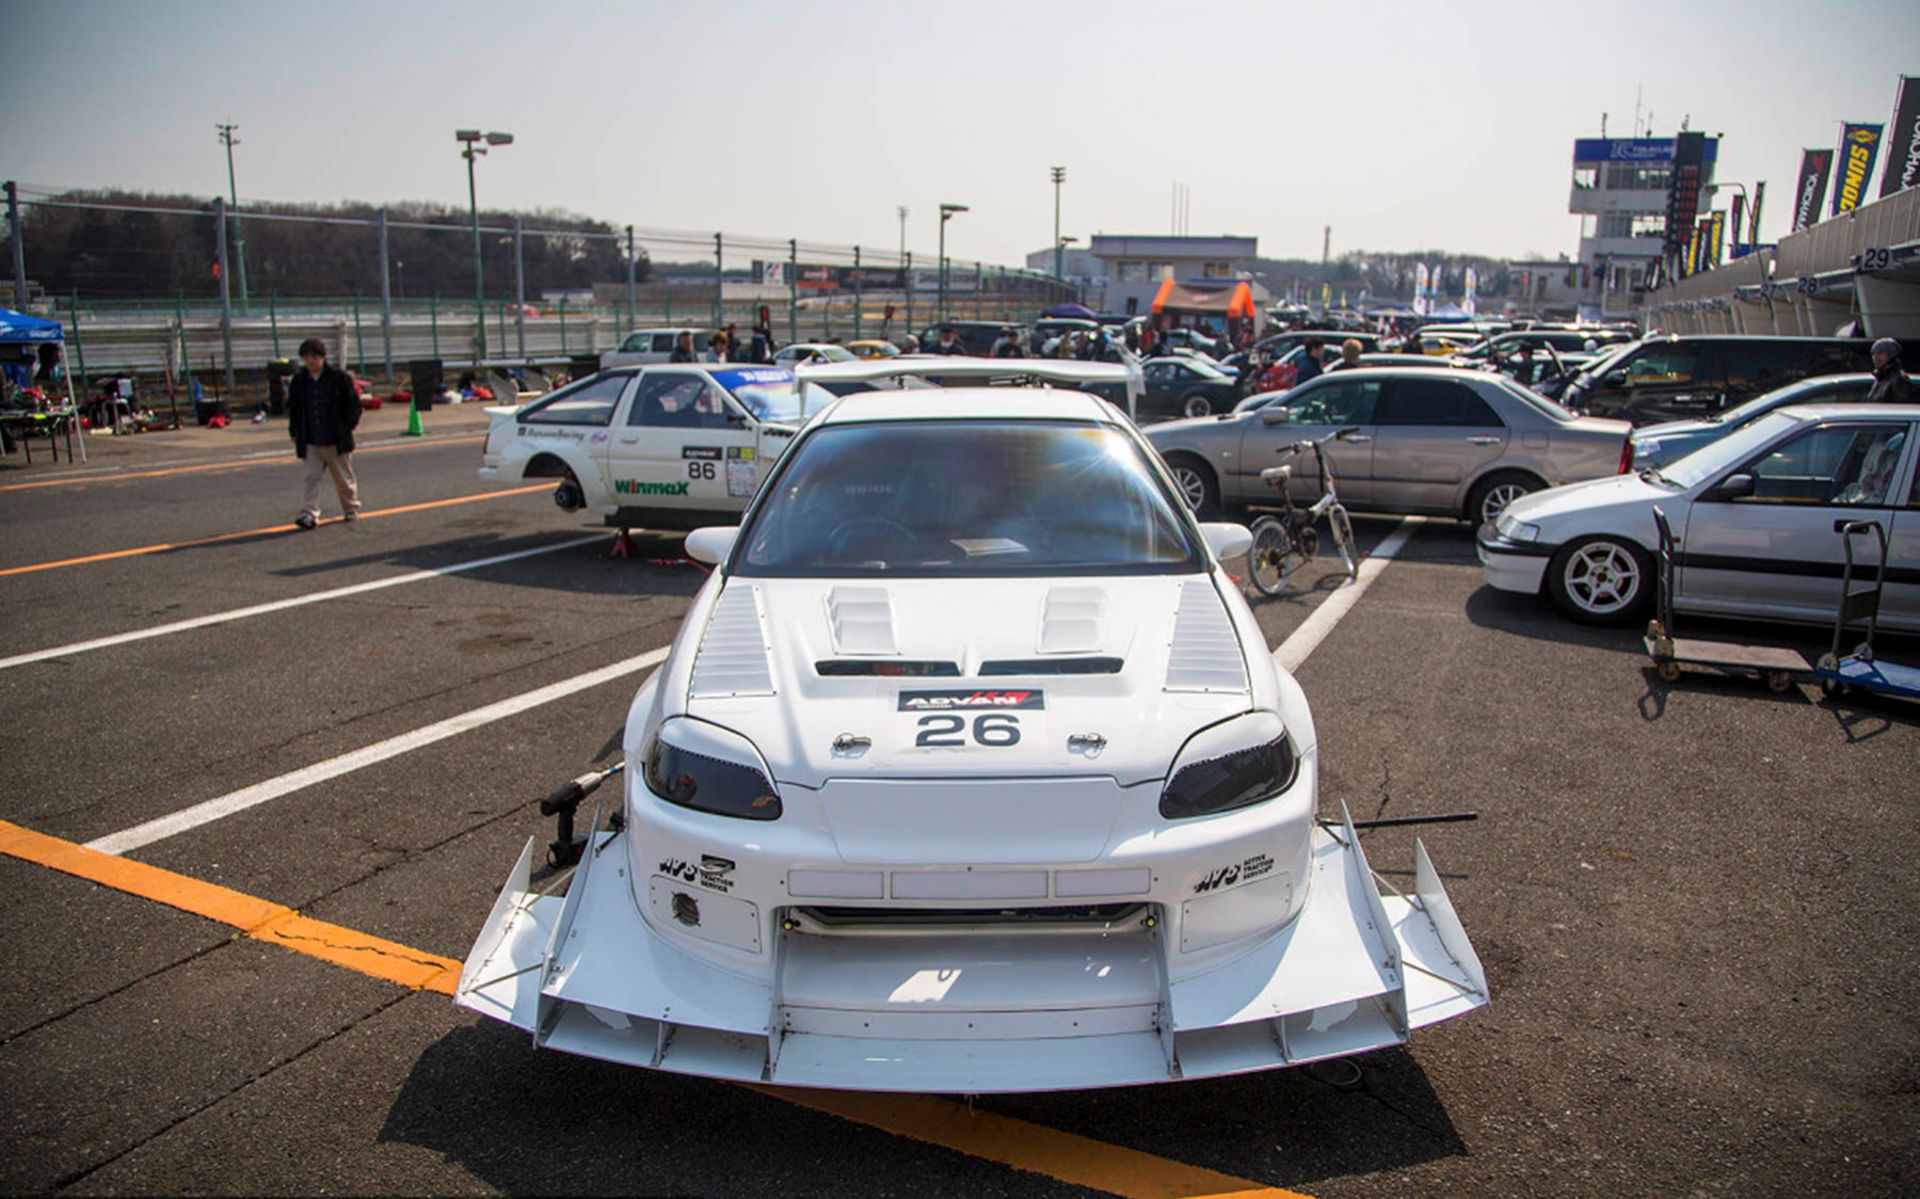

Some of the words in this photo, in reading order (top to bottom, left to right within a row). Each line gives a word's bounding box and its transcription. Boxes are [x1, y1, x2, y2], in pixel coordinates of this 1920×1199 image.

[1865, 249, 1889, 268] 29
[1798, 277, 1817, 293] 28
[688, 461, 716, 480] 86
[905, 692, 1025, 707] ADVAN
[916, 714, 1021, 747] 26
